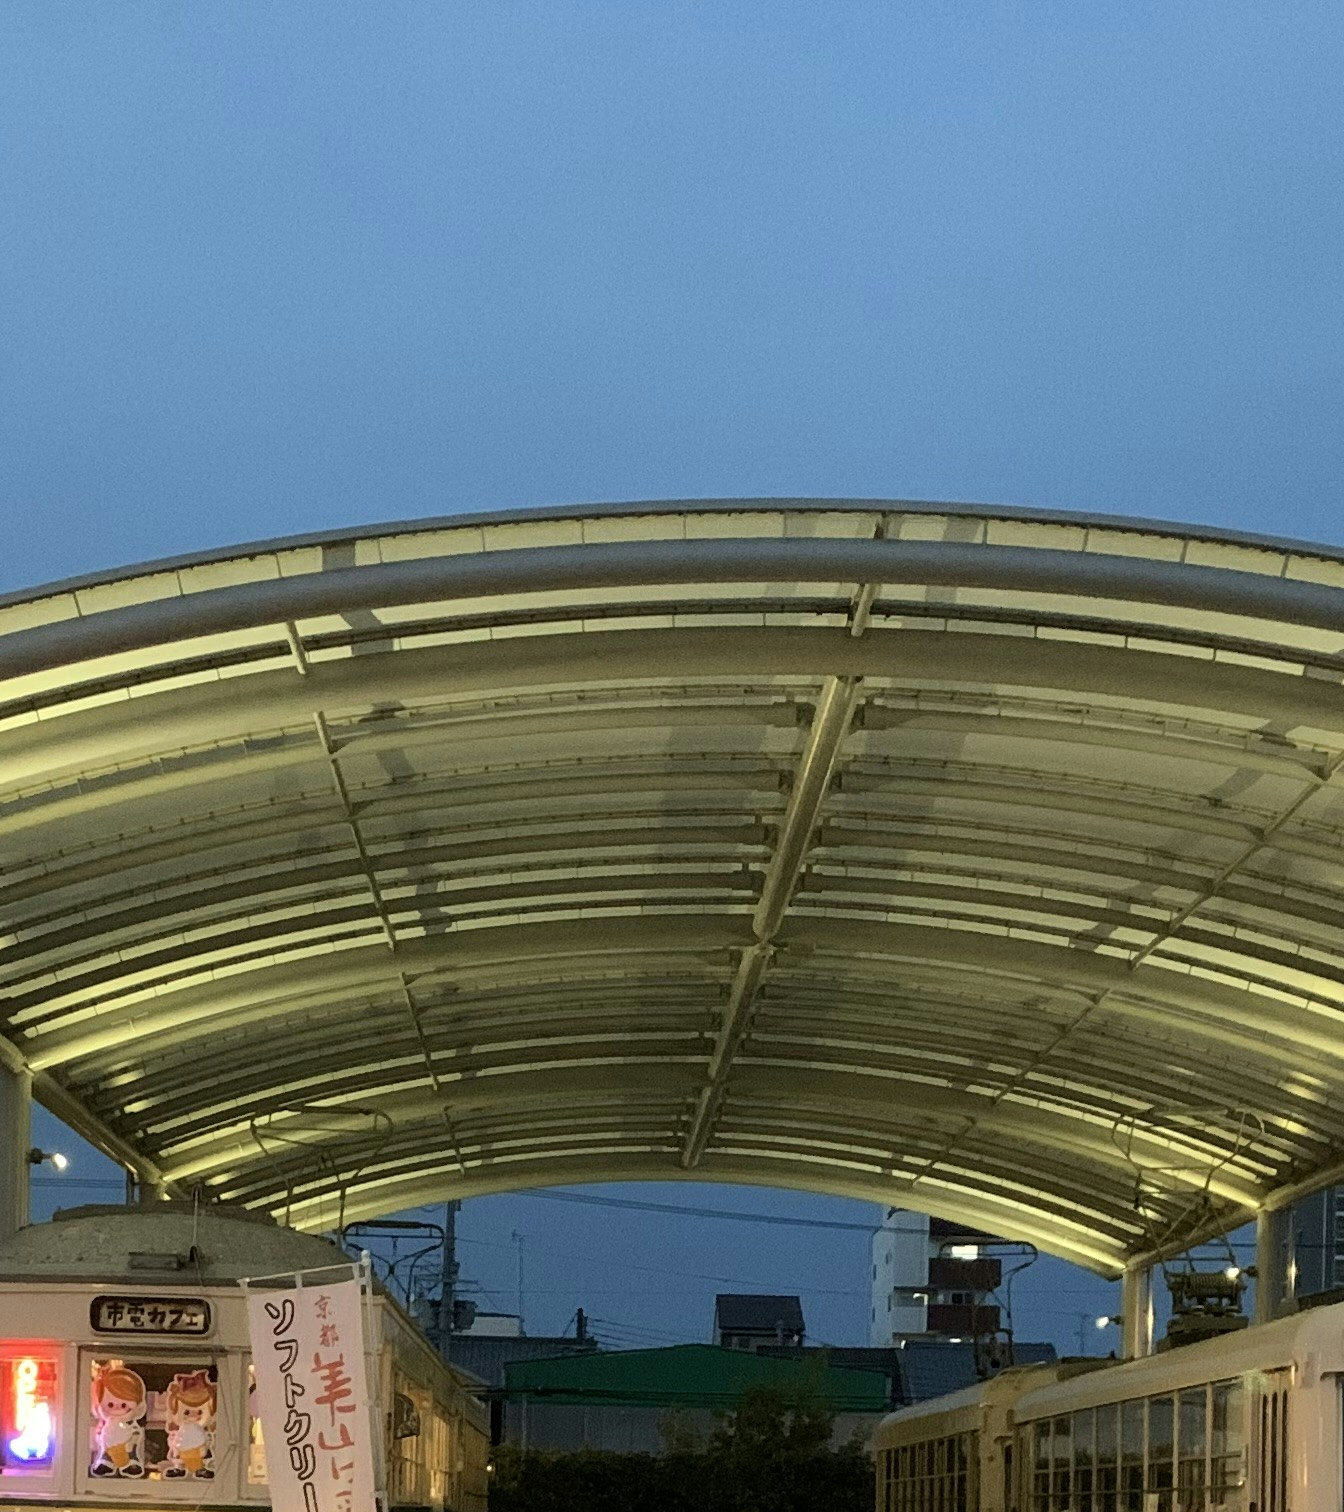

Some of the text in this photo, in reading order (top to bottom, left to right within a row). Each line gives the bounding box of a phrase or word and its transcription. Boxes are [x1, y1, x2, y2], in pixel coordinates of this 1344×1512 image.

[106, 1301, 198, 1329] 市電カフェ
